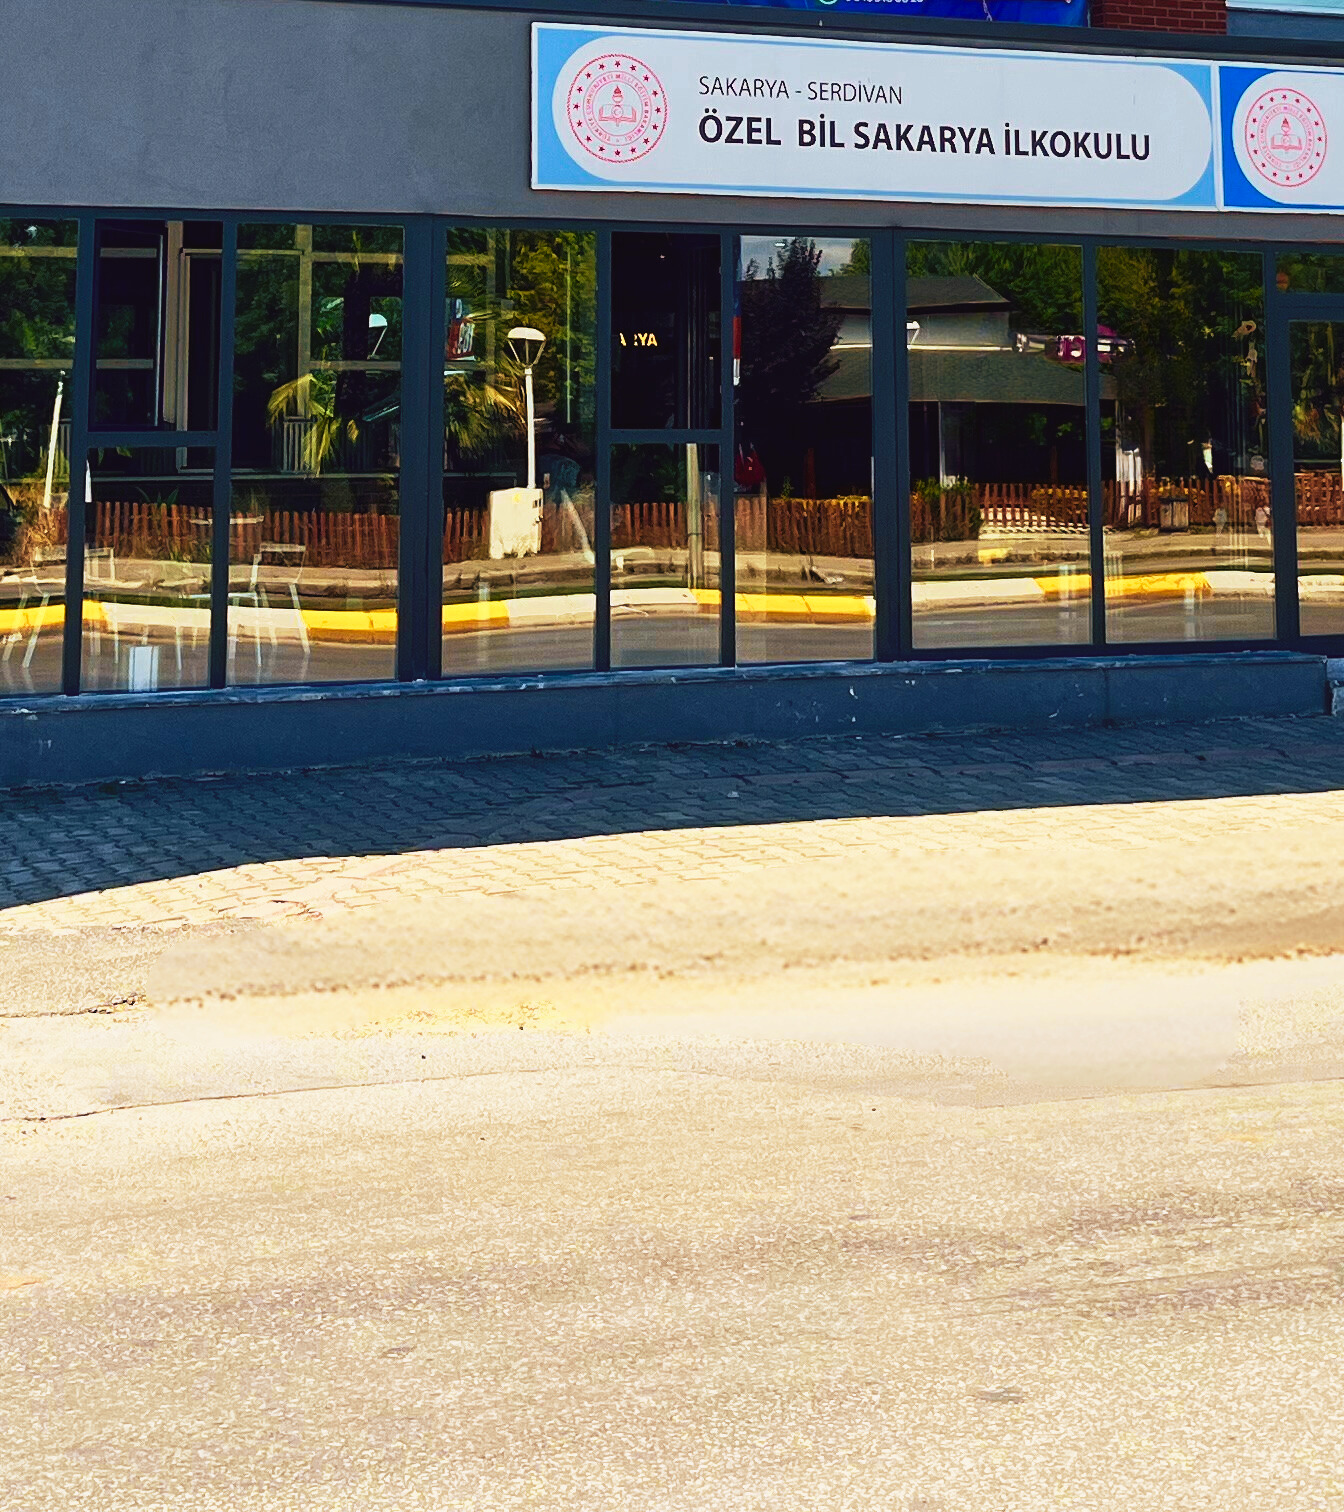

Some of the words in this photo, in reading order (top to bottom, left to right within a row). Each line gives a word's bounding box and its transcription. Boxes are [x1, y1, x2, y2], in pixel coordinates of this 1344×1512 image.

[698, 75, 790, 99] SAKARYA
[807, 80, 903, 105] SERDİVAN
[698, 107, 782, 146] ÖZEL
[797, 113, 846, 148] BİL
[853, 121, 996, 156] SAKARYA
[1003, 122, 1151, 161] İLKOKULU
